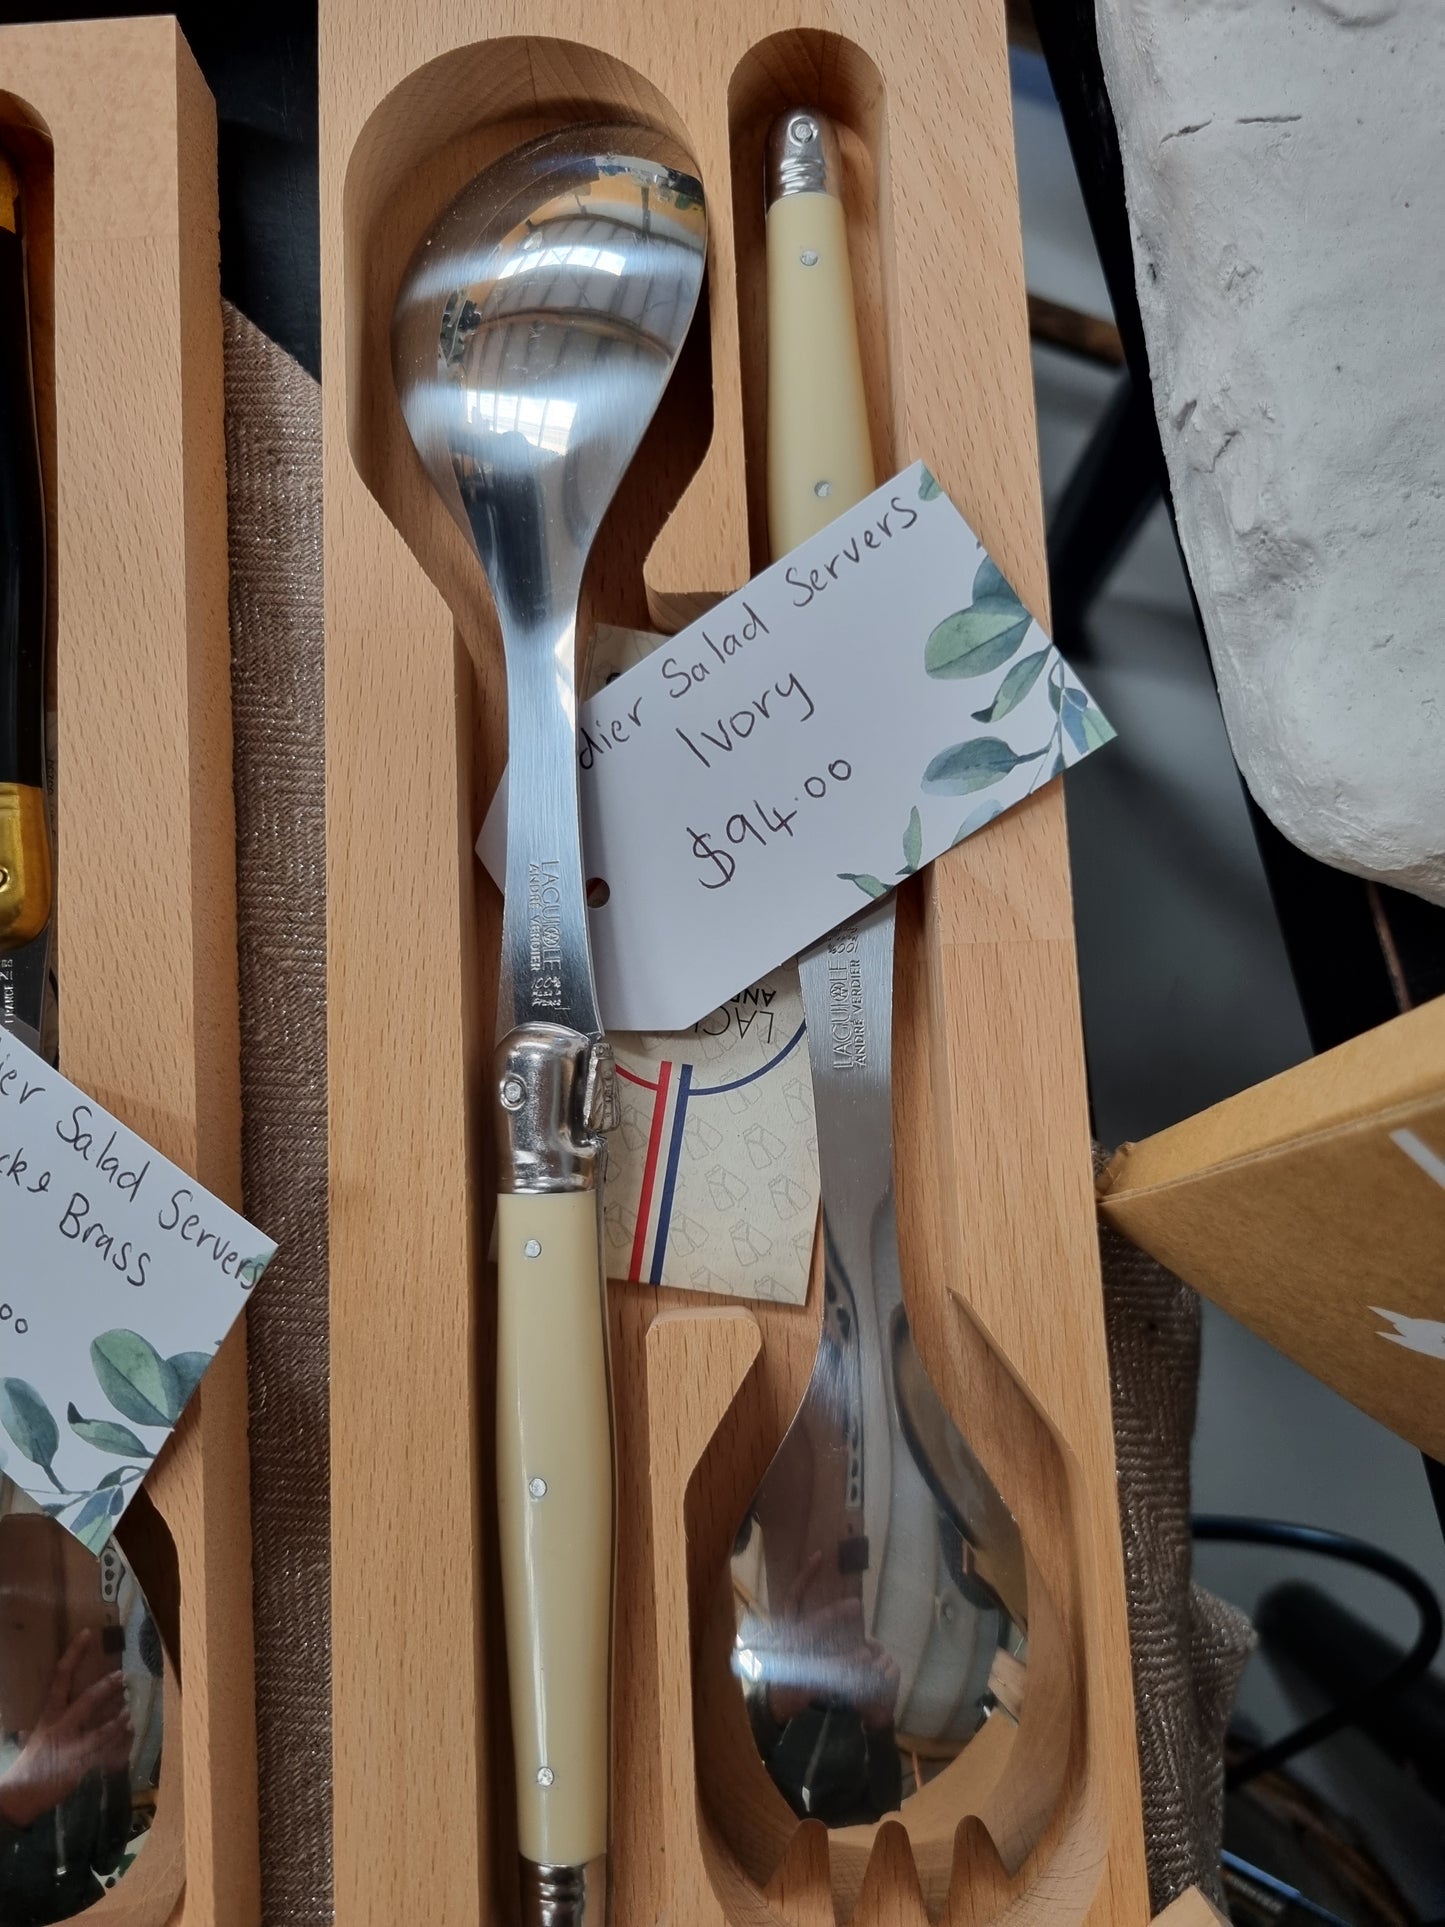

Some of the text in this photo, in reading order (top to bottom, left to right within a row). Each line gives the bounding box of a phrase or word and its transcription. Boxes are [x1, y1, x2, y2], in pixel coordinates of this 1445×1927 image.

[662, 602, 770, 698] Salad
[785, 497, 917, 607] Servers
[676, 673, 814, 767] Ivory
[687, 759, 852, 889] $94.00
[529, 914, 542, 971] VERDIER
[850, 959, 863, 1015] VERDIER
[56, 1105, 150, 1202] Salad
[159, 1189, 265, 1290] Servers
[59, 1192, 151, 1286] Brass
